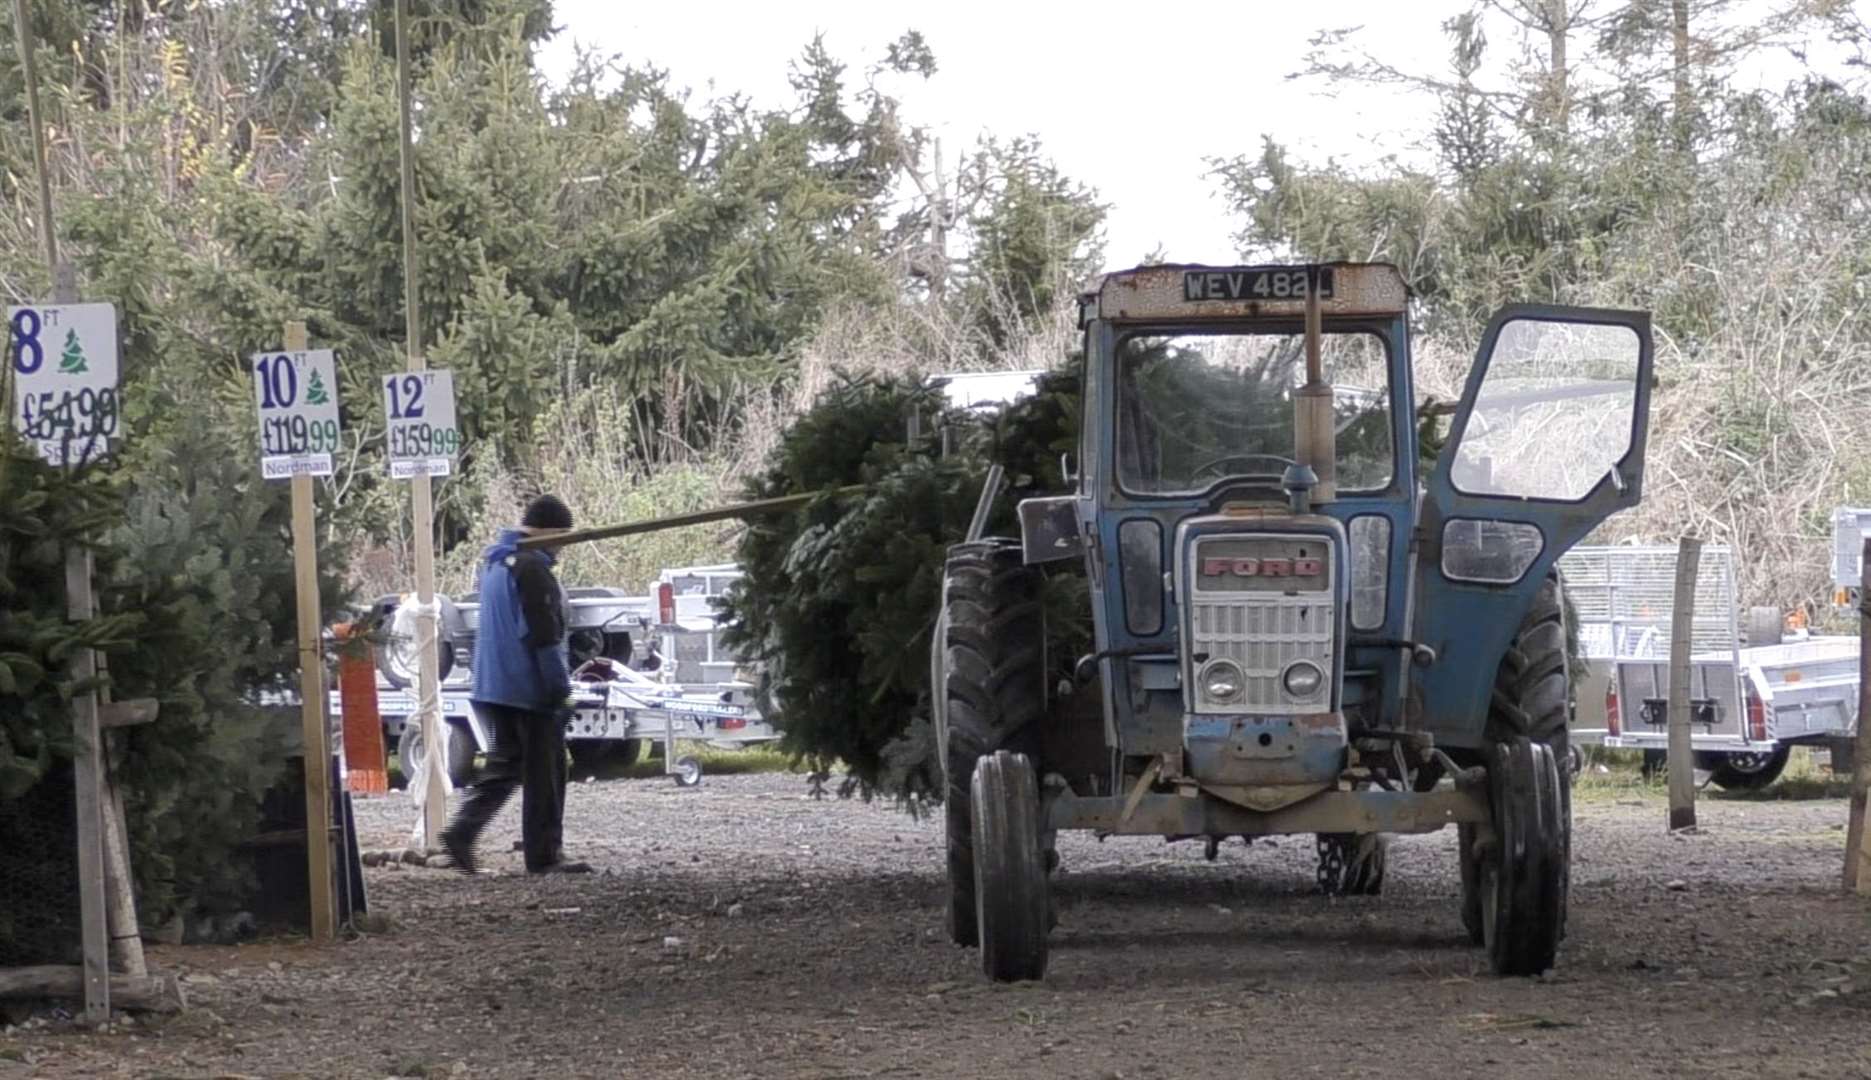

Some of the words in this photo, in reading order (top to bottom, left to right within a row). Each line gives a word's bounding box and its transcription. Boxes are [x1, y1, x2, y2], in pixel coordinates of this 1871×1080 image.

[1187, 273, 1244, 299] WEV
[1252, 271, 1331, 298] 482L
[12, 309, 43, 375] 8
[43, 309, 60, 327] FT
[256, 354, 297, 409] 10
[294, 353, 307, 366] FT
[386, 375, 425, 419] 12
[424, 373, 435, 384] FT
[266, 460, 329, 475] Nordman
[394, 463, 447, 476] Nordman
[1204, 556, 1321, 576] FORD
